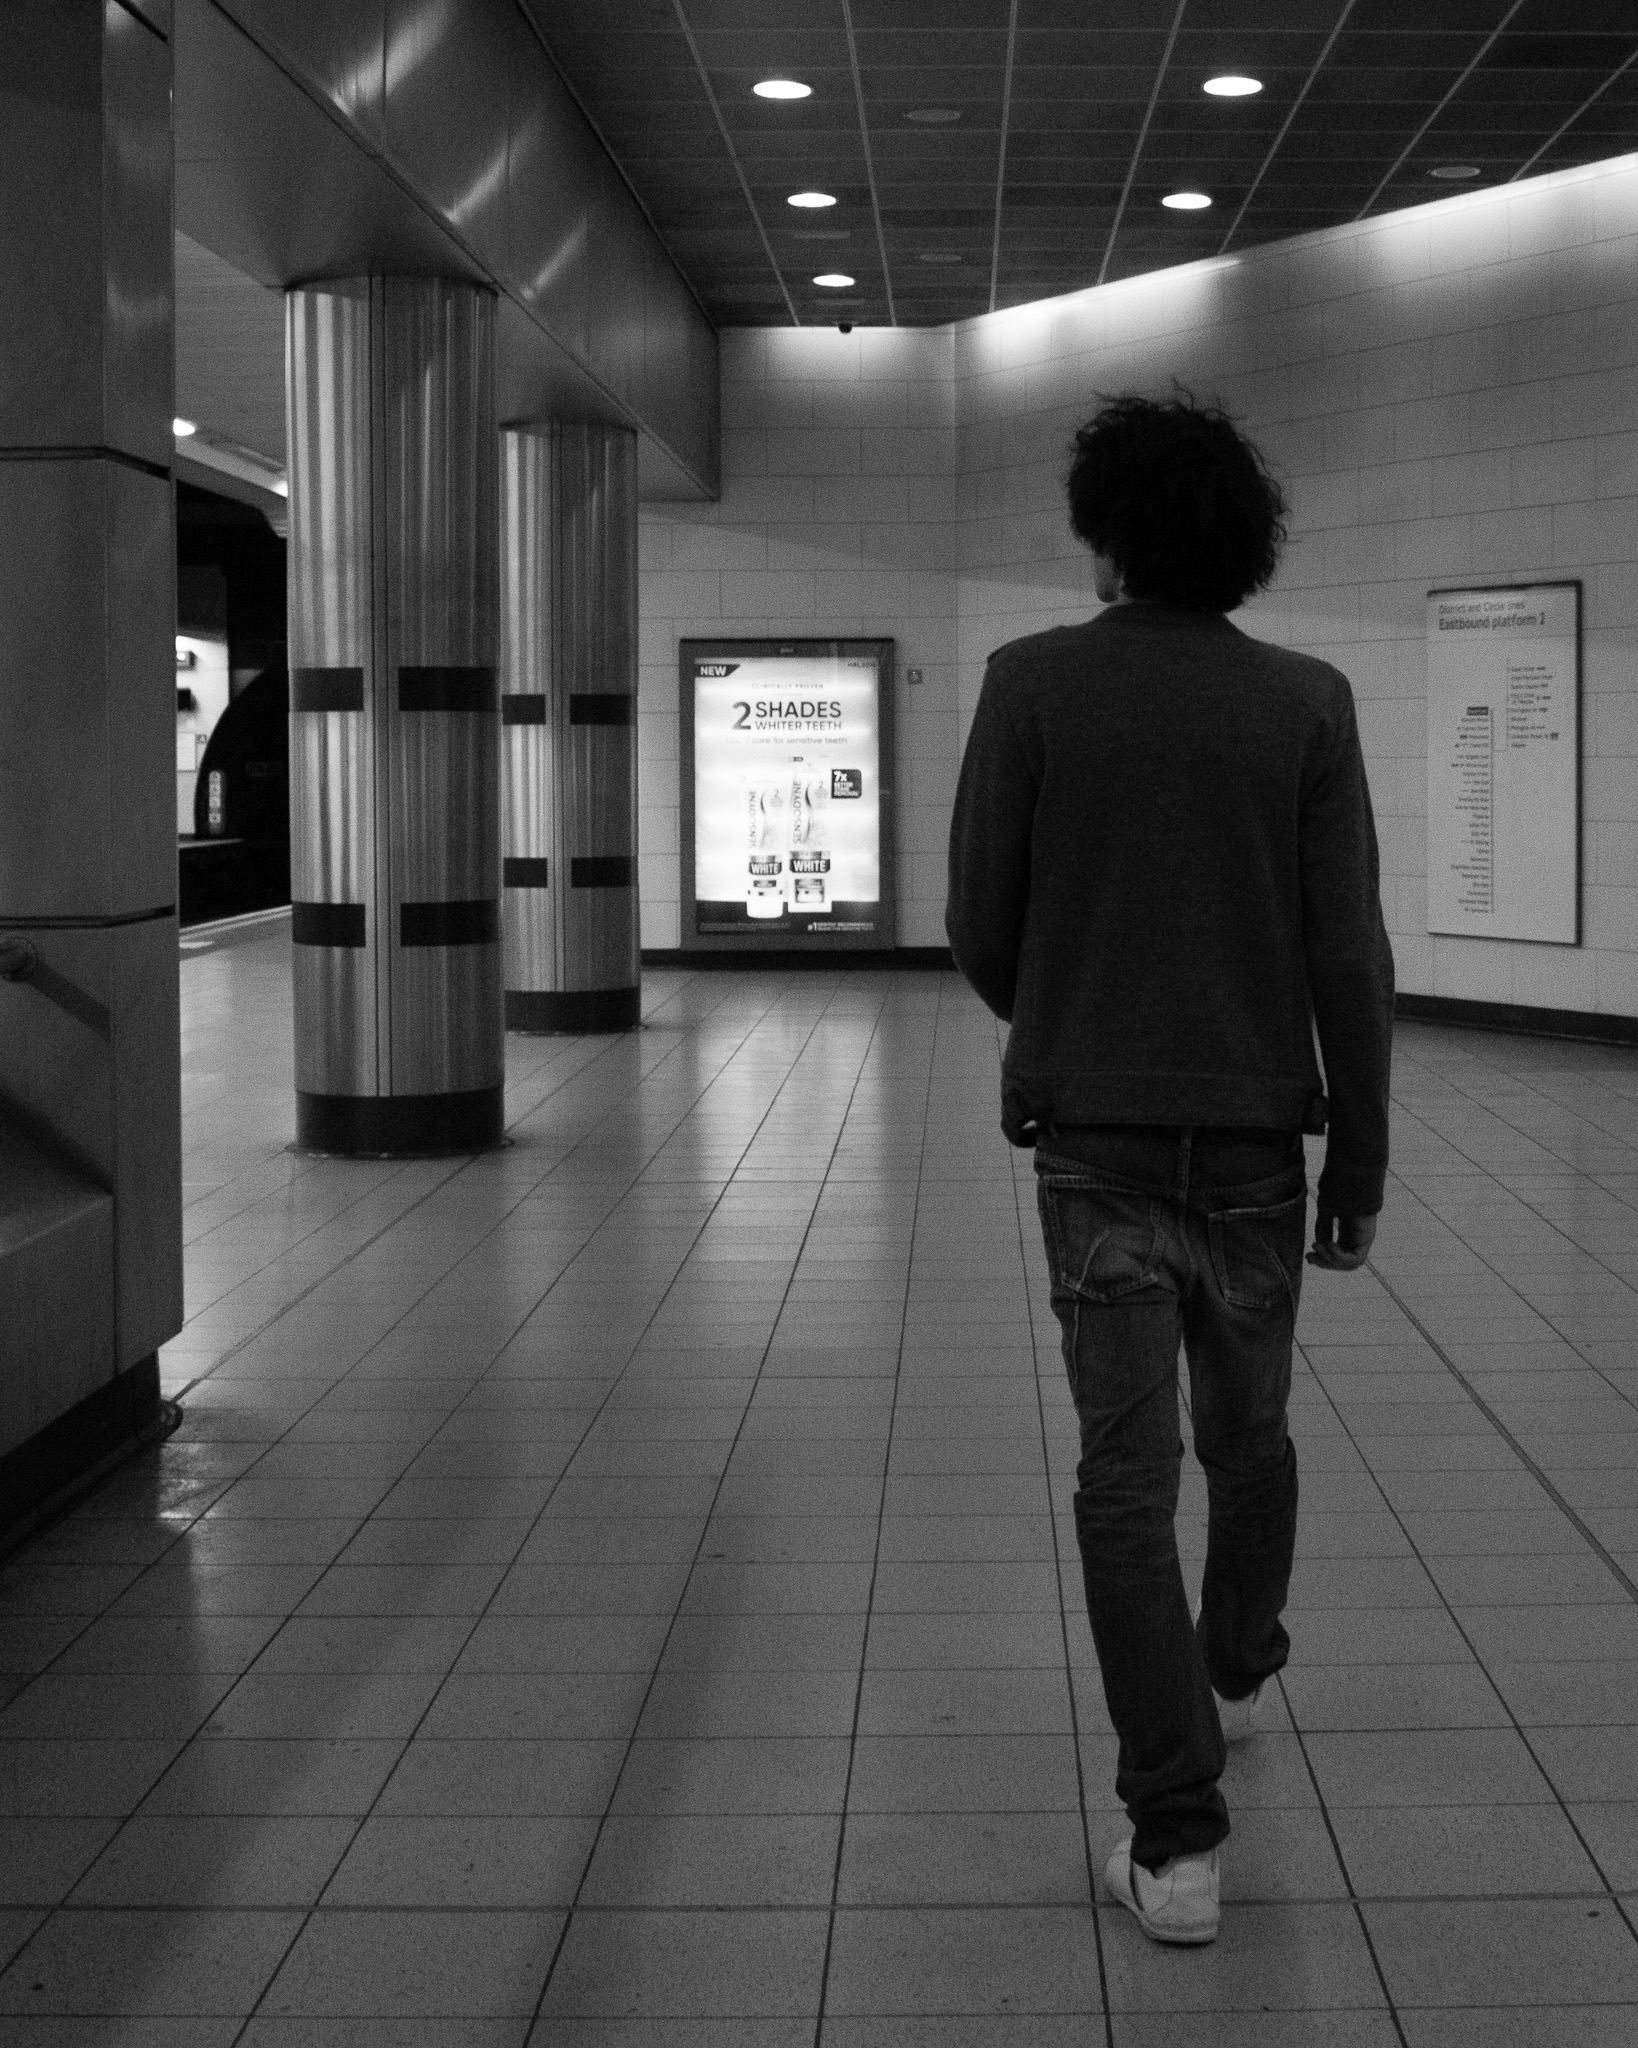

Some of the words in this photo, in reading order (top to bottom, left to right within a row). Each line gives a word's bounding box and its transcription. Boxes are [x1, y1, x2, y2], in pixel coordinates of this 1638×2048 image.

[1438, 616, 1490, 631] Eastbound
[1492, 613, 1538, 630] platform
[700, 665, 728, 677] NEW
[732, 701, 752, 731] 2
[755, 701, 842, 719] SHADES
[755, 720, 803, 731] WHITER
[806, 720, 842, 731] TEETH
[751, 737, 771, 745] care
[773, 736, 784, 745] for
[786, 736, 823, 745] sensitive
[825, 736, 848, 745] teeth
[833, 770, 848, 782] 7x
[792, 780, 802, 844] SENSODYNE
[751, 863, 779, 875] WHITE
[793, 859, 826, 872] WHITE
